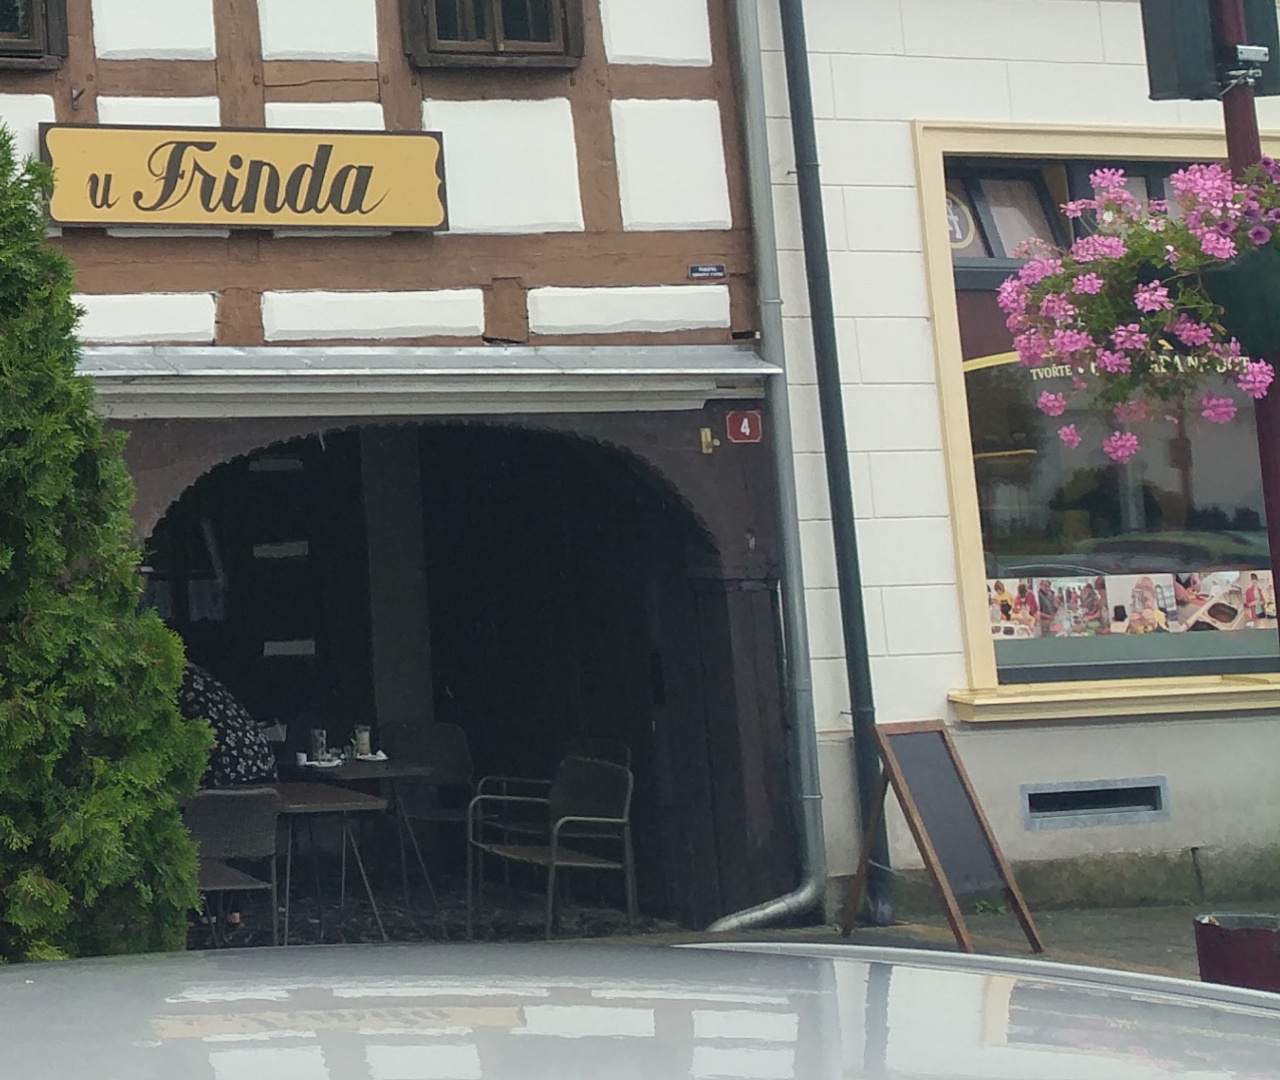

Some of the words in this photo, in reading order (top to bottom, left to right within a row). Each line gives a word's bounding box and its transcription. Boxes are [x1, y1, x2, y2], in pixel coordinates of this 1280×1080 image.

[86, 172, 120, 210] u
[132, 139, 390, 216] Frinda
[1029, 363, 1073, 381] TVOŘTE
[740, 417, 750, 436] 4
